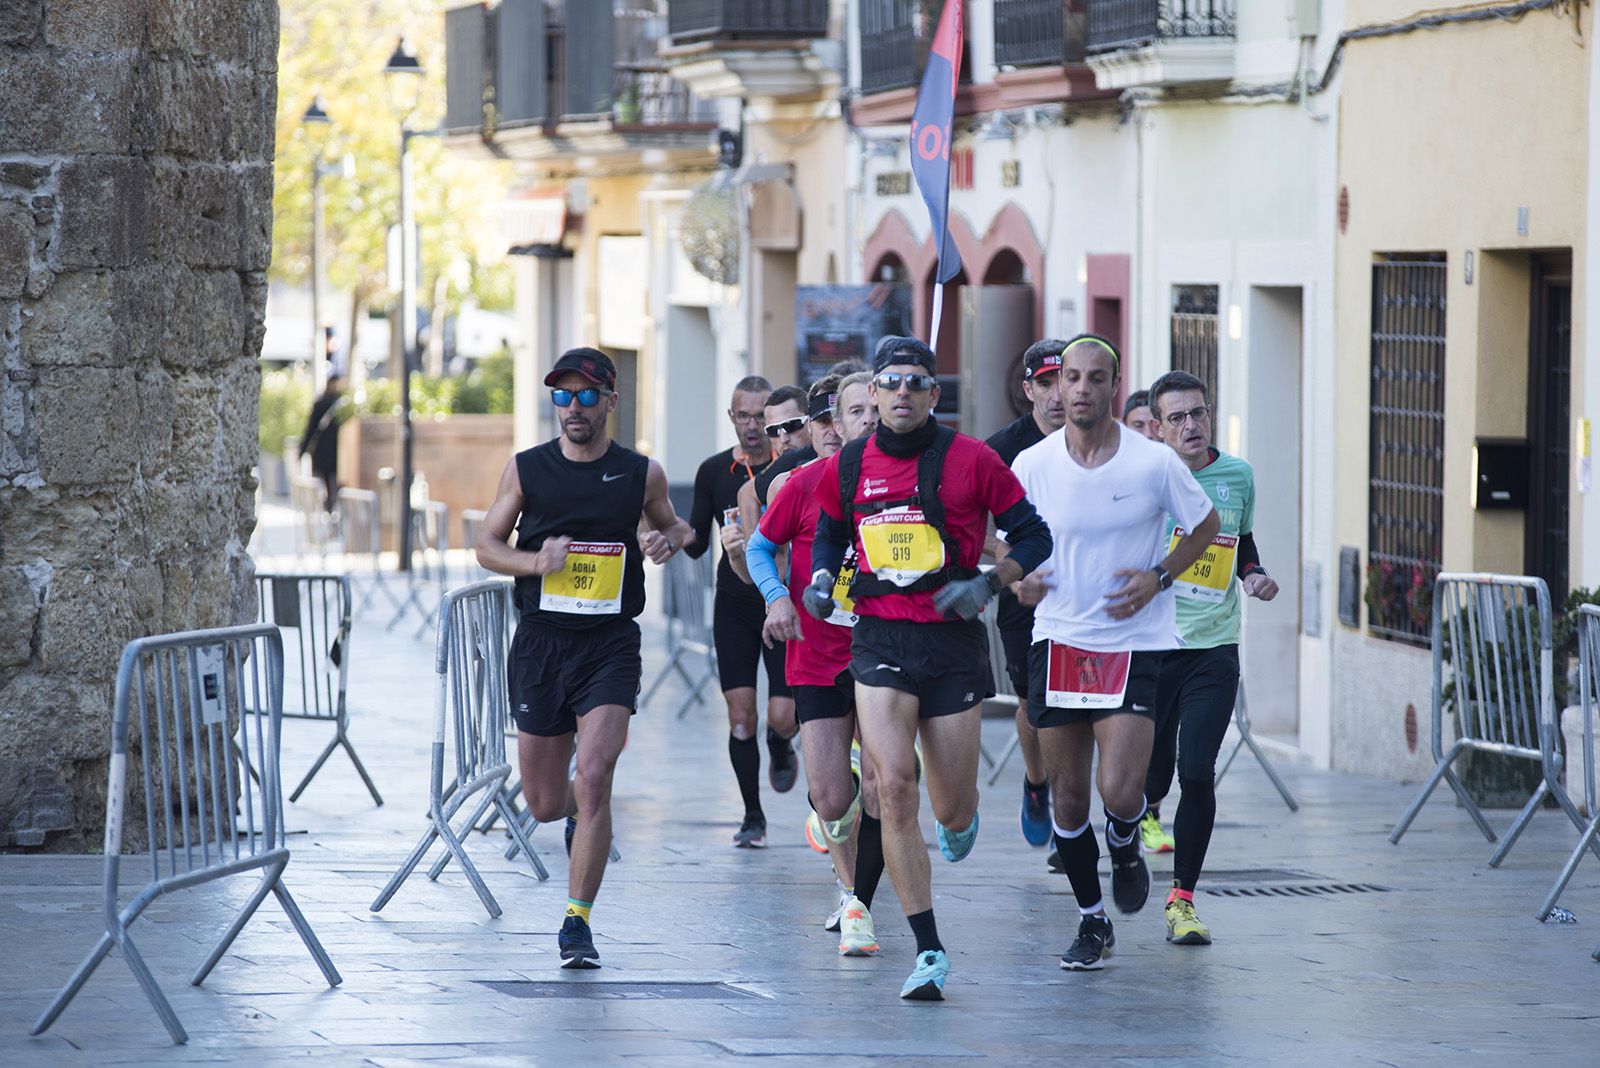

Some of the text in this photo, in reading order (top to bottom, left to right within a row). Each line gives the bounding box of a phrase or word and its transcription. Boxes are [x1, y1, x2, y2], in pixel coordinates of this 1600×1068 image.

[884, 514, 904, 522] SANT
[1219, 509, 1235, 525] tik
[888, 532, 914, 544] JOSEP
[892, 547, 911, 560] 919
[1199, 551, 1216, 562] ORDI
[1193, 563, 1211, 578] 549
[574, 576, 594, 590] 387
[837, 575, 850, 586] ESA
